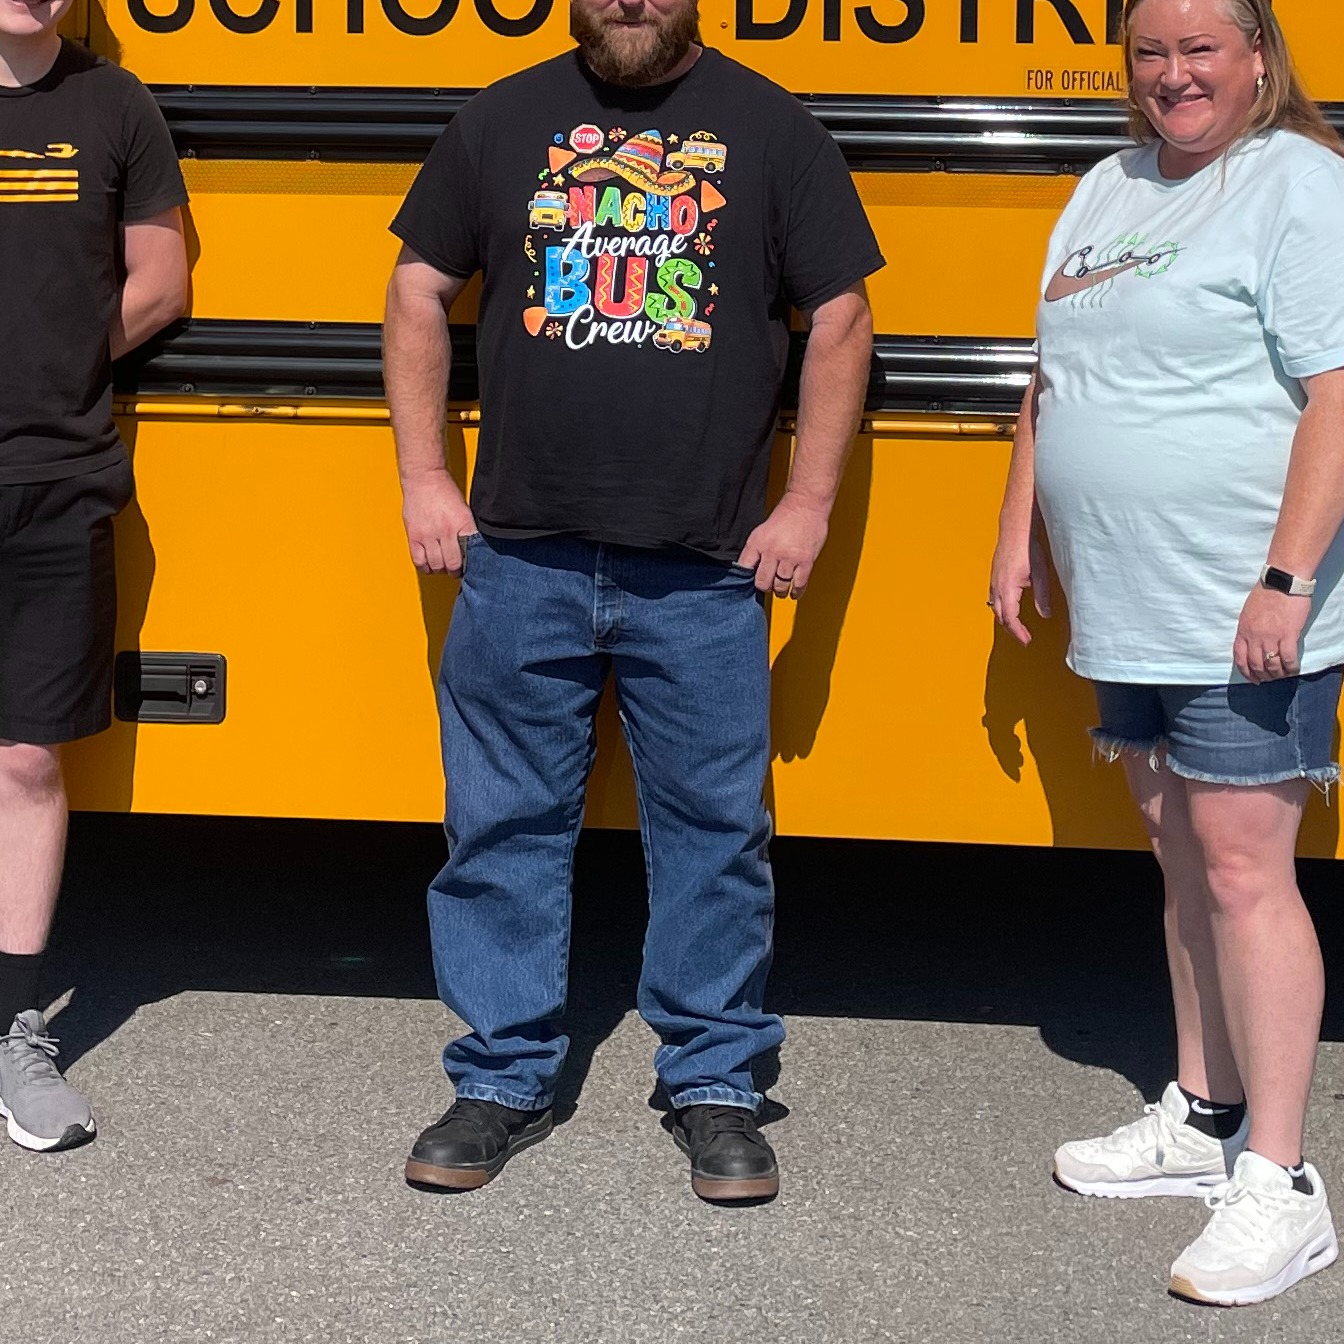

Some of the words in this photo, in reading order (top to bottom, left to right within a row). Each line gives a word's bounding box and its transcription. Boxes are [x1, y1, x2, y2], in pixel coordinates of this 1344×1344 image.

[1026, 69, 1054, 91] FOR
[1061, 69, 1124, 93] OFFICIAL
[574, 132, 600, 145] STOP
[568, 185, 699, 236] NACHO
[561, 221, 688, 267] Average
[544, 246, 703, 325] BUS
[565, 304, 656, 350] Crew
